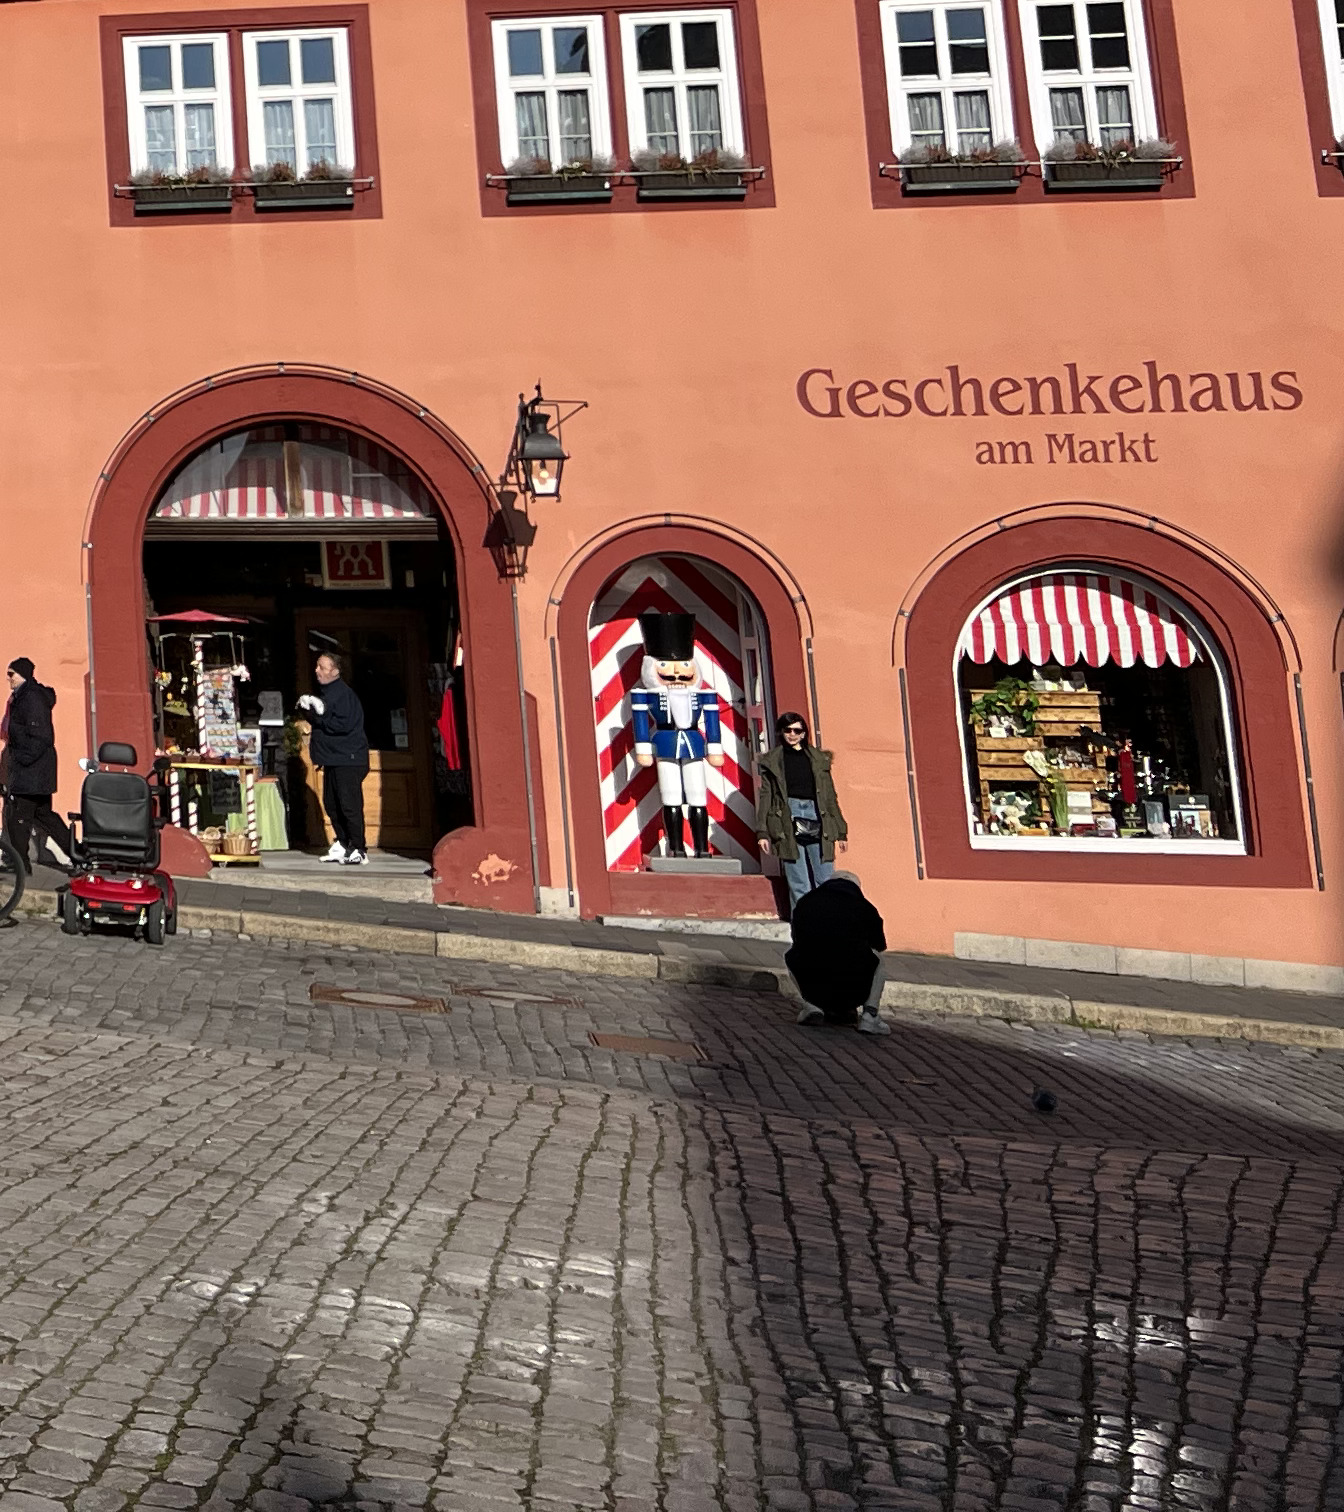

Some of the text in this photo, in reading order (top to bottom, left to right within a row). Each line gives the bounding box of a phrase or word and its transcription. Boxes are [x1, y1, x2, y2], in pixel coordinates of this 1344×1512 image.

[796, 361, 1304, 418] Geschenkehaus
[975, 431, 1160, 465] am Markt
